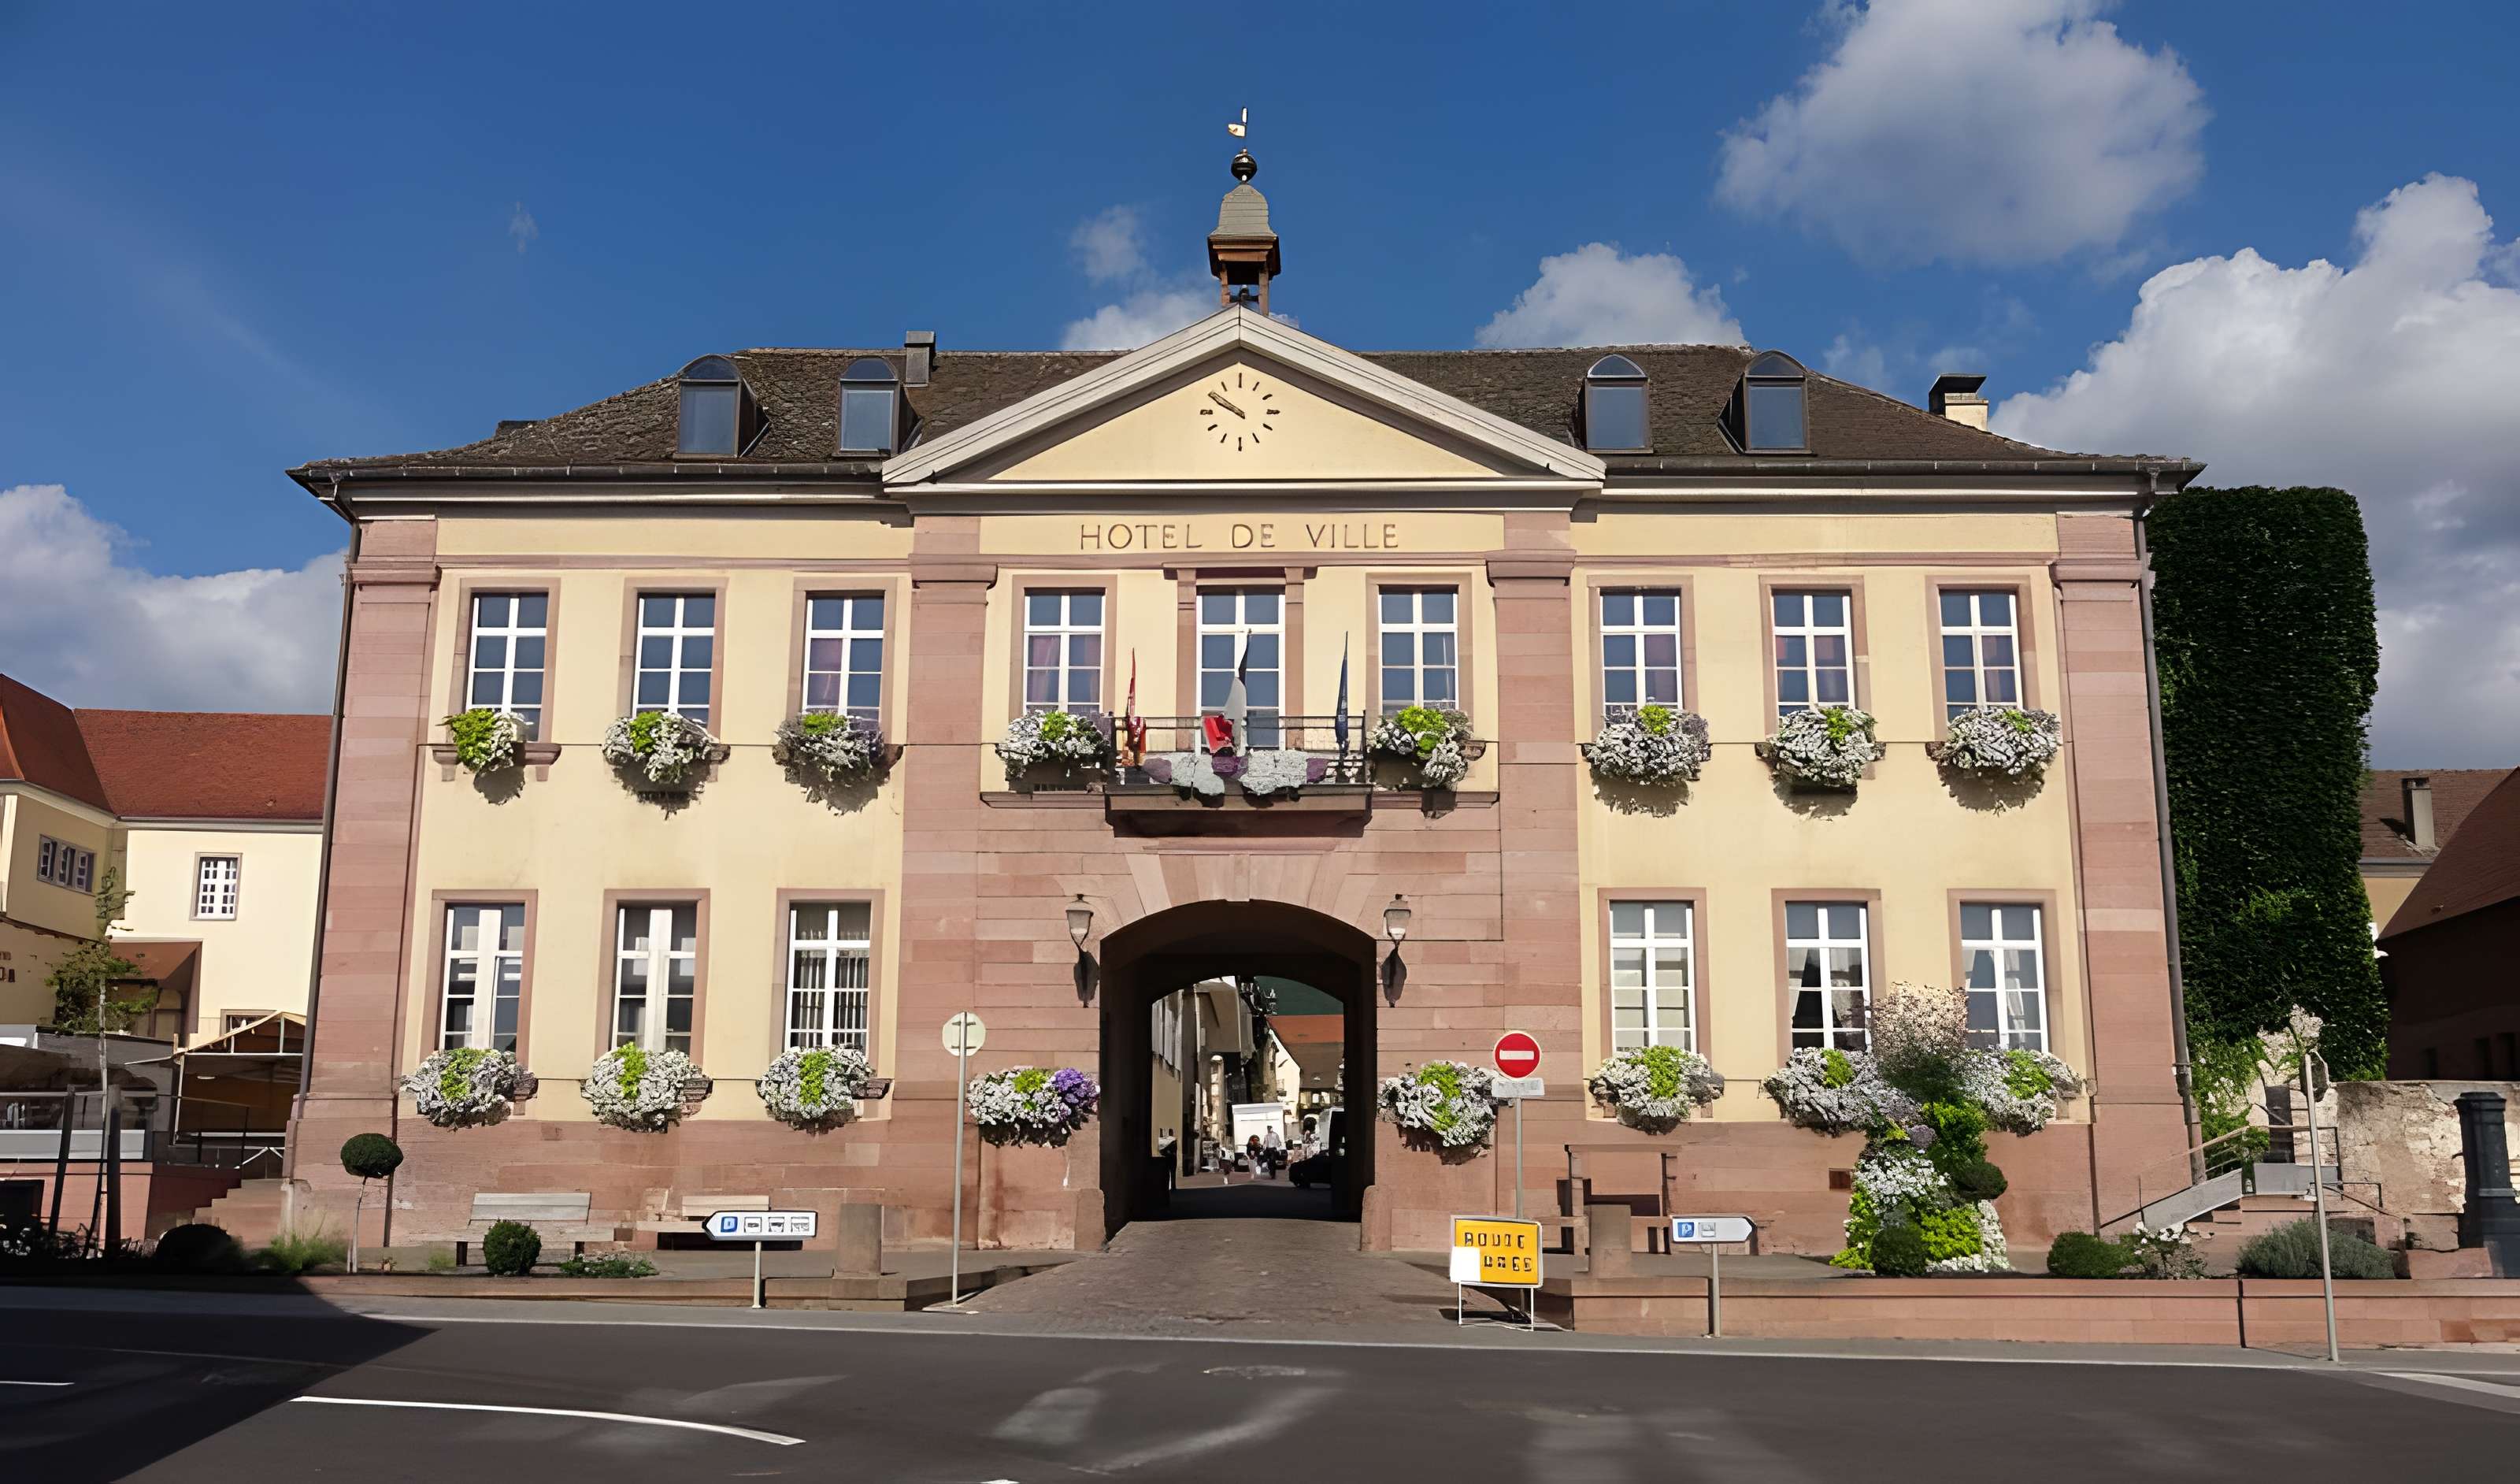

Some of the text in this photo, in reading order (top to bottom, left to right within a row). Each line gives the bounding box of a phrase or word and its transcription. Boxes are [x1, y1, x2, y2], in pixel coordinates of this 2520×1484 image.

[1080, 523, 1399, 550] HOTEL DE VILLE
